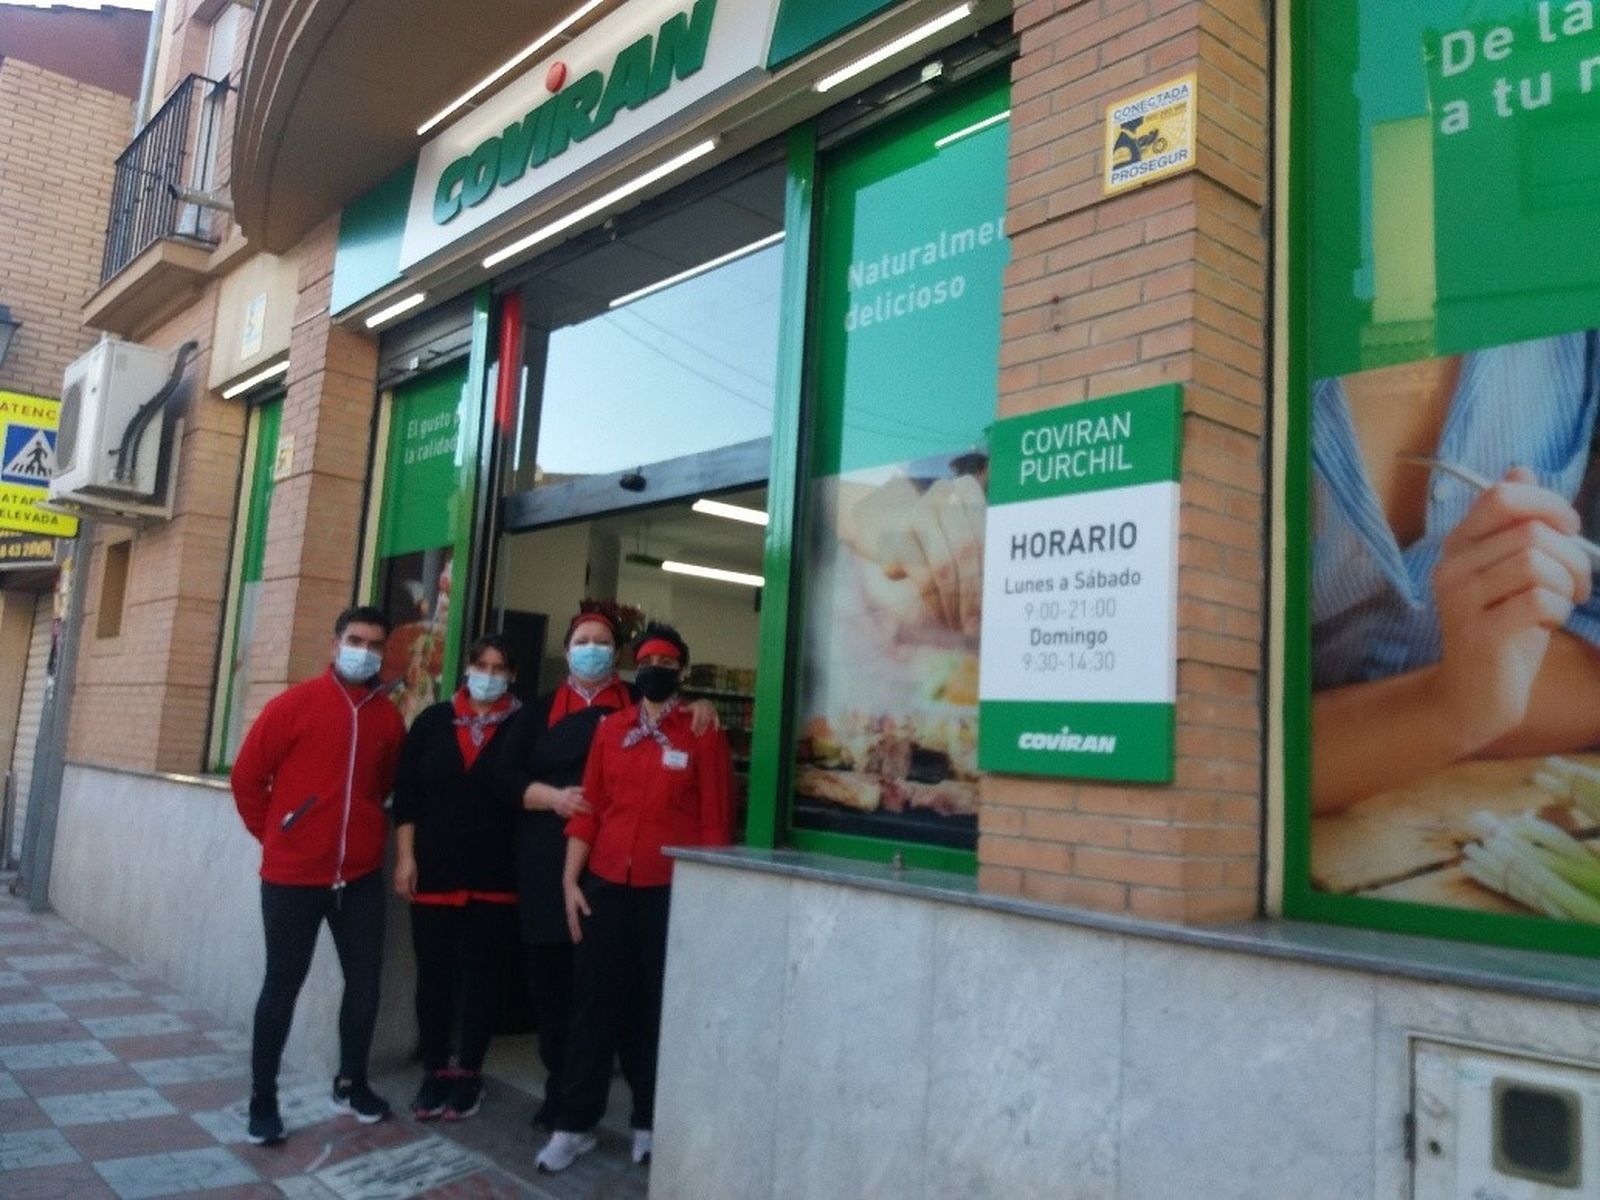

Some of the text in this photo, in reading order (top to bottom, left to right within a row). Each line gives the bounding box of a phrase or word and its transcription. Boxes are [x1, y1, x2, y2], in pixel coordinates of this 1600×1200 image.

[1442, 0, 1593, 78] De la
[432, 0, 716, 226] COVIRAN
[1113, 84, 1189, 120] CONECTADA
[1440, 99, 1470, 135] a
[1493, 71, 1552, 117] tu
[1111, 148, 1188, 184] PROSEGUR
[845, 275, 966, 332] delicioso
[0, 402, 56, 420] ATENC
[1021, 411, 1131, 456] COVIRAN
[1020, 444, 1133, 486] PURCHIL
[1010, 521, 1138, 561] HORARIO
[1005, 567, 1141, 595] Lunes a Sábado
[1030, 627, 1108, 650] Domingo
[1019, 726, 1116, 754] COVIRAN
